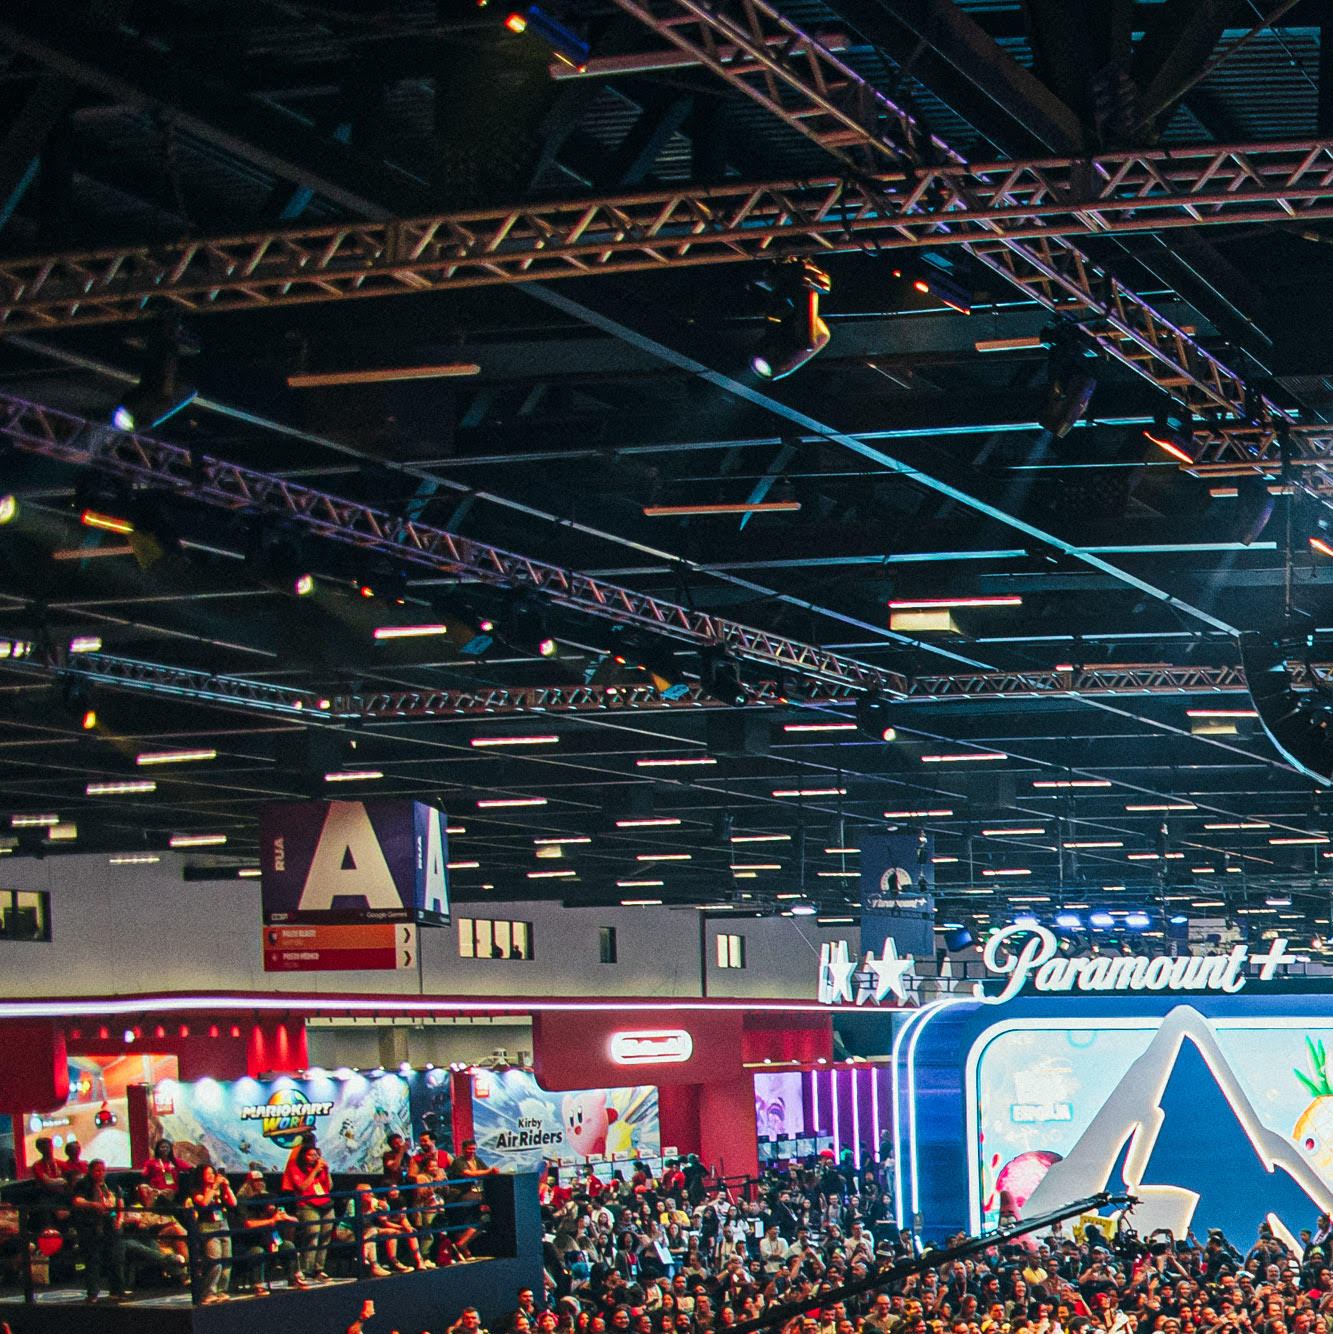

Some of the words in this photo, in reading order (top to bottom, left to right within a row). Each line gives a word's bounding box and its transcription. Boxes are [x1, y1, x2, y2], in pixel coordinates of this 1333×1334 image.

[274, 837, 286, 872] RUA
[298, 801, 404, 910] A
[518, 1117, 542, 1130] Kirby
